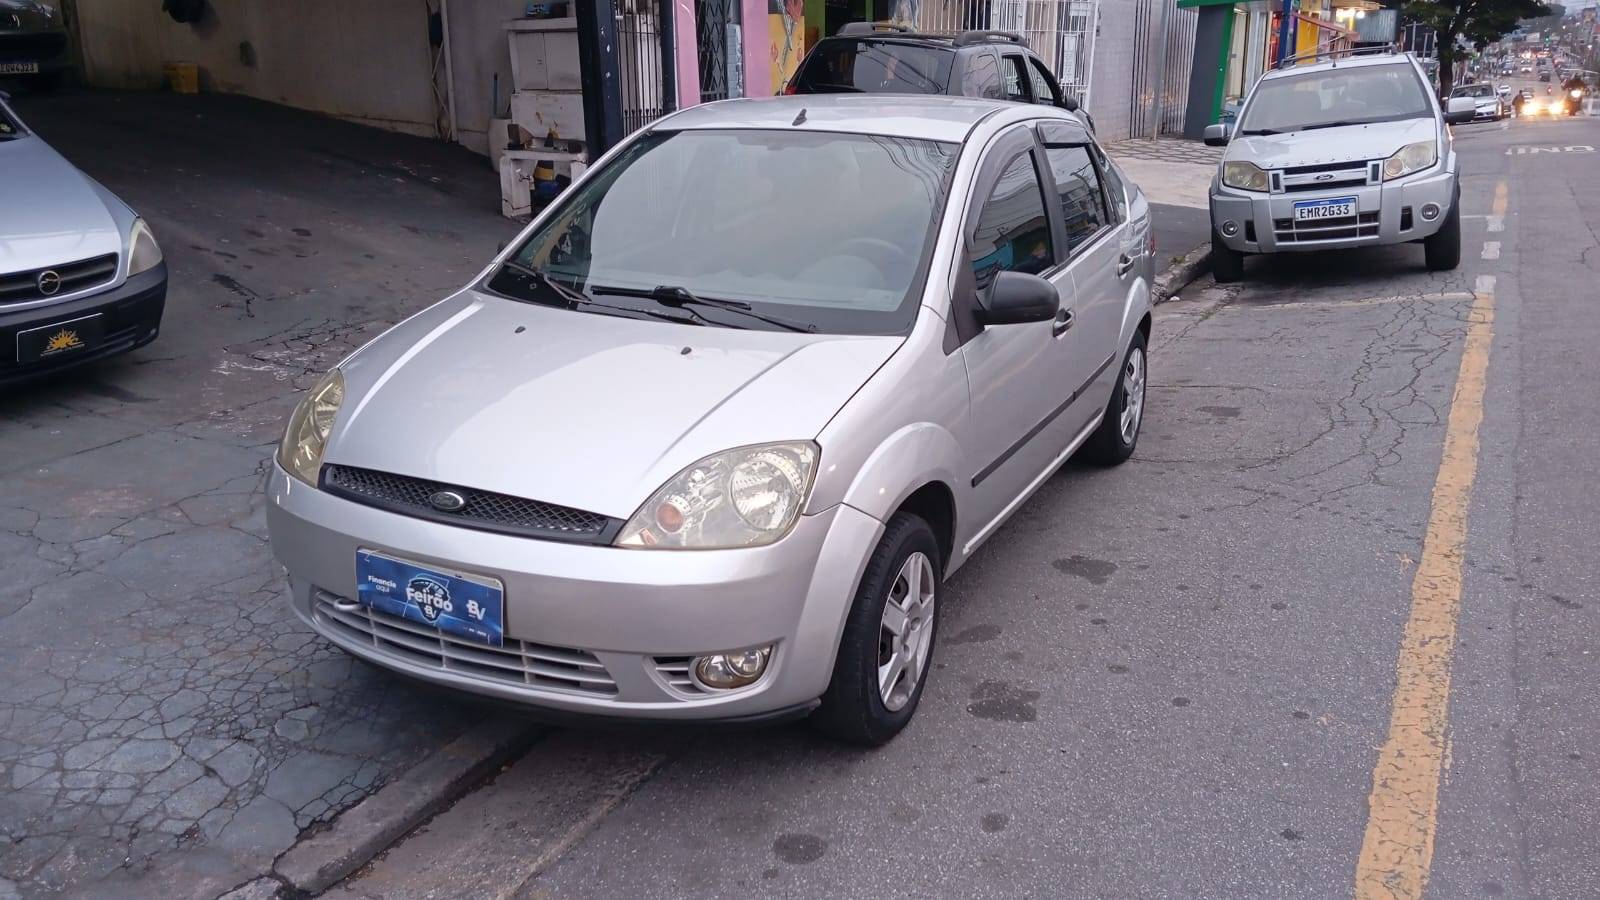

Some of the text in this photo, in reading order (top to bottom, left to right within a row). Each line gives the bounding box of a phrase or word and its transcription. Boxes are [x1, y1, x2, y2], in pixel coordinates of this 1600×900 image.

[1300, 204, 1350, 219] EMR2G33
[368, 575, 397, 588] Financie
[406, 587, 453, 612] Feirão
